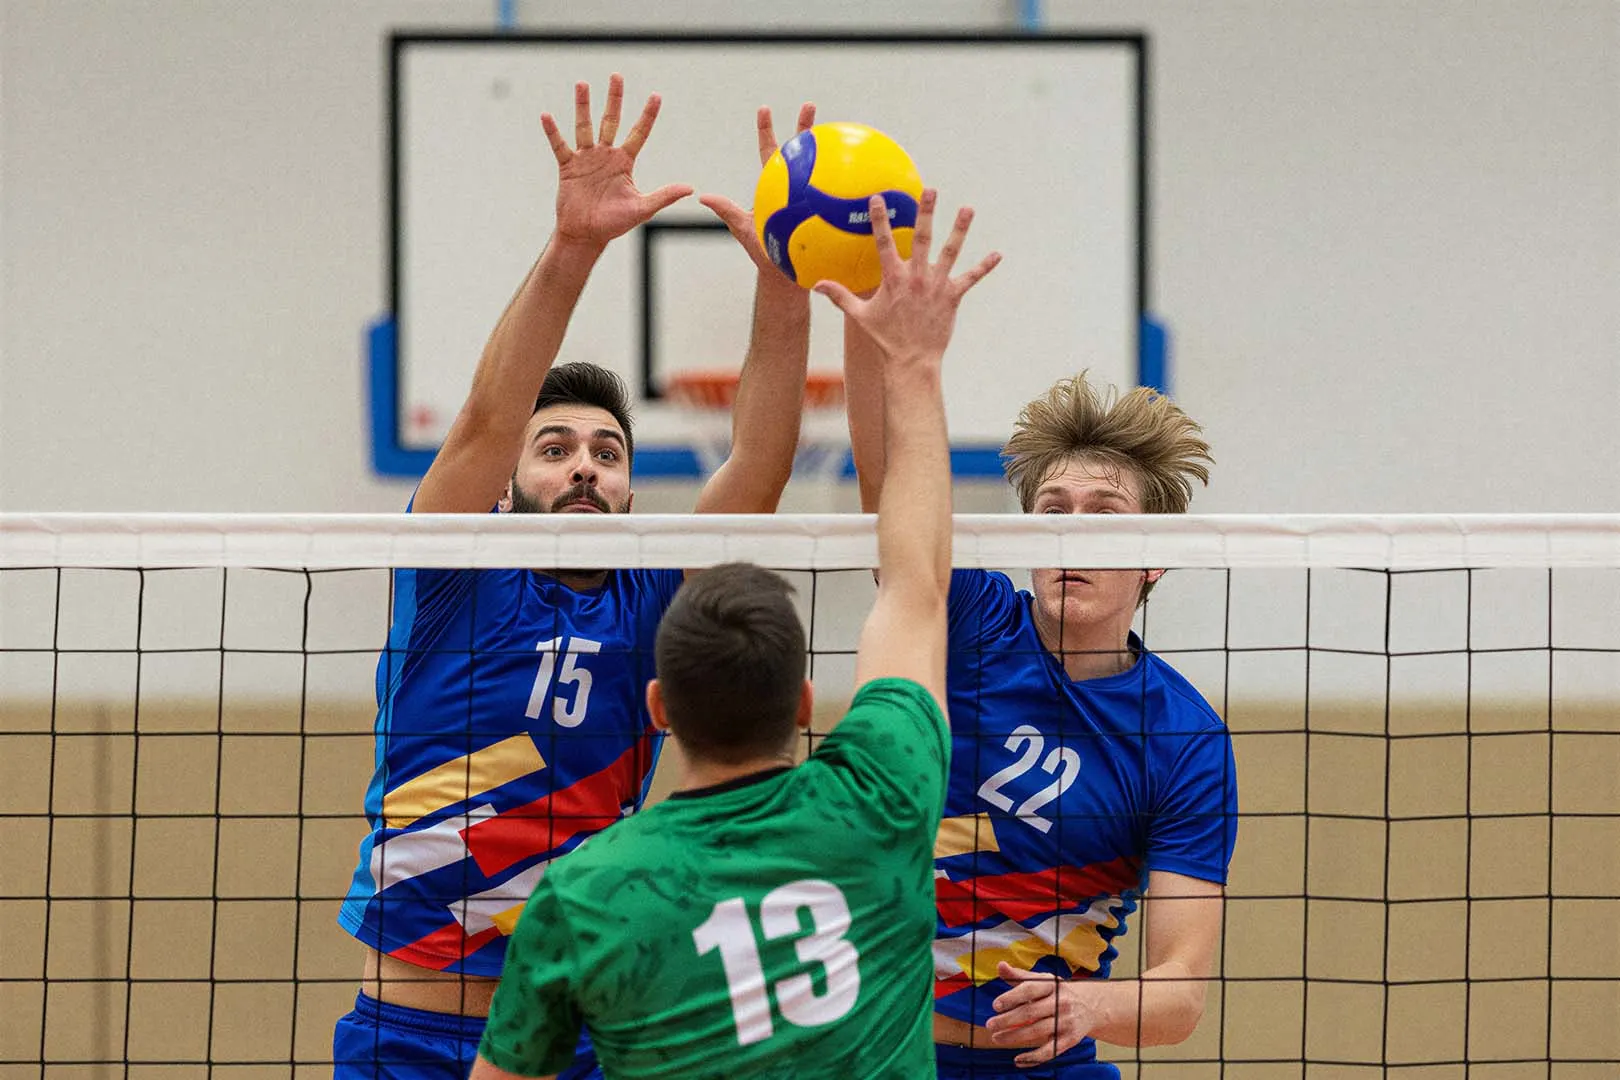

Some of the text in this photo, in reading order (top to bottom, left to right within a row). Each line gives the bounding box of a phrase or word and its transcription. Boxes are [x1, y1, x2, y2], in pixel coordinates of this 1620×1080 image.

[525, 636, 601, 728] 15
[977, 724, 1082, 834] 22
[693, 879, 861, 1045] 13
